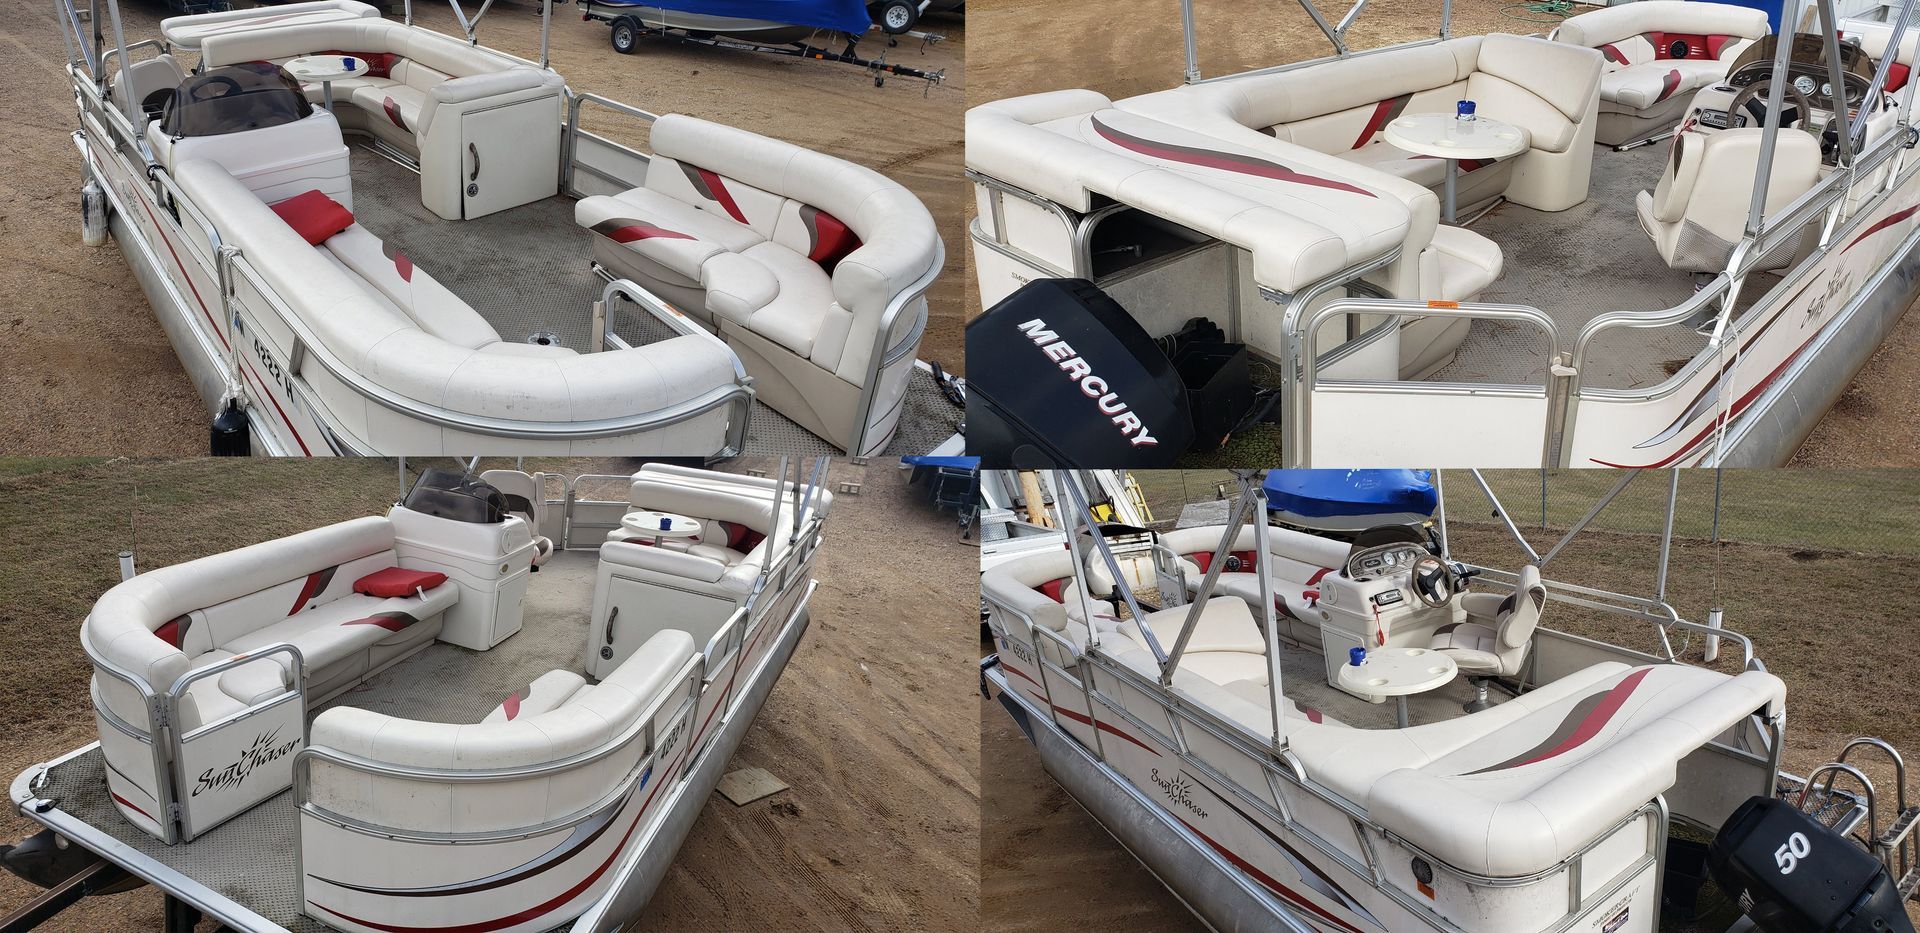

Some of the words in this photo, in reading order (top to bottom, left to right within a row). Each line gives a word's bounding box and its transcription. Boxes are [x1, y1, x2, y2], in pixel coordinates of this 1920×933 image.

[254, 339, 282, 388] 4222
[285, 376, 294, 404] H
[1017, 318, 1159, 447] MERCURY
[191, 736, 302, 798] SunChaser
[1150, 767, 1208, 820] SunChaser
[1774, 831, 1811, 875] 50
